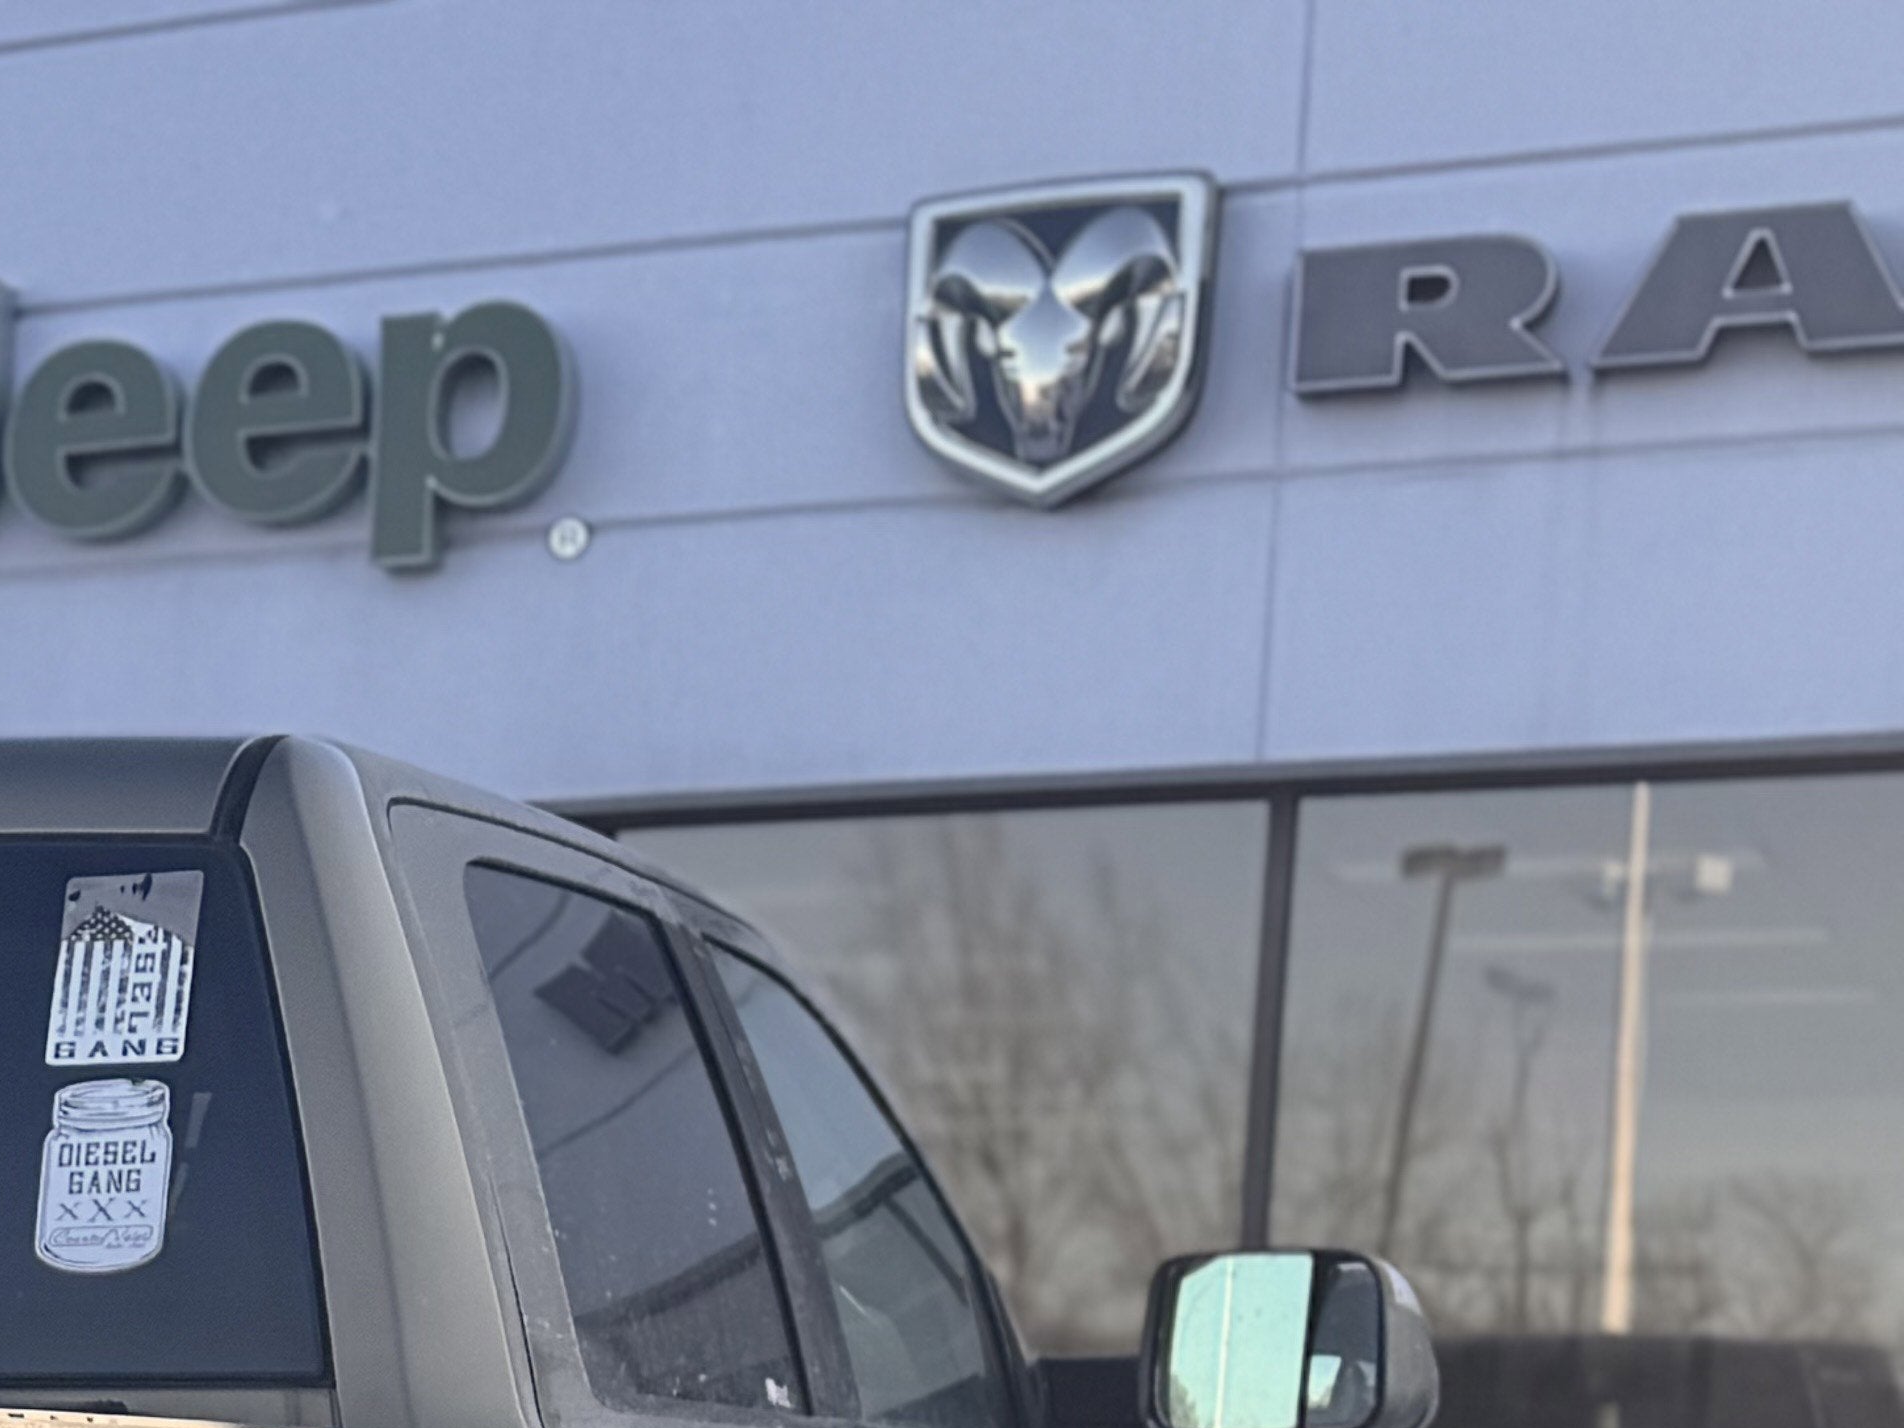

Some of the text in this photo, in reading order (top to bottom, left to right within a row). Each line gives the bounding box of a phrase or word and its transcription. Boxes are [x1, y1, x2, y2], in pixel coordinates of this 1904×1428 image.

[53, 1037, 180, 1060] GANG
[57, 1138, 157, 1168] DIESEL
[67, 1168, 143, 1196] GANG
